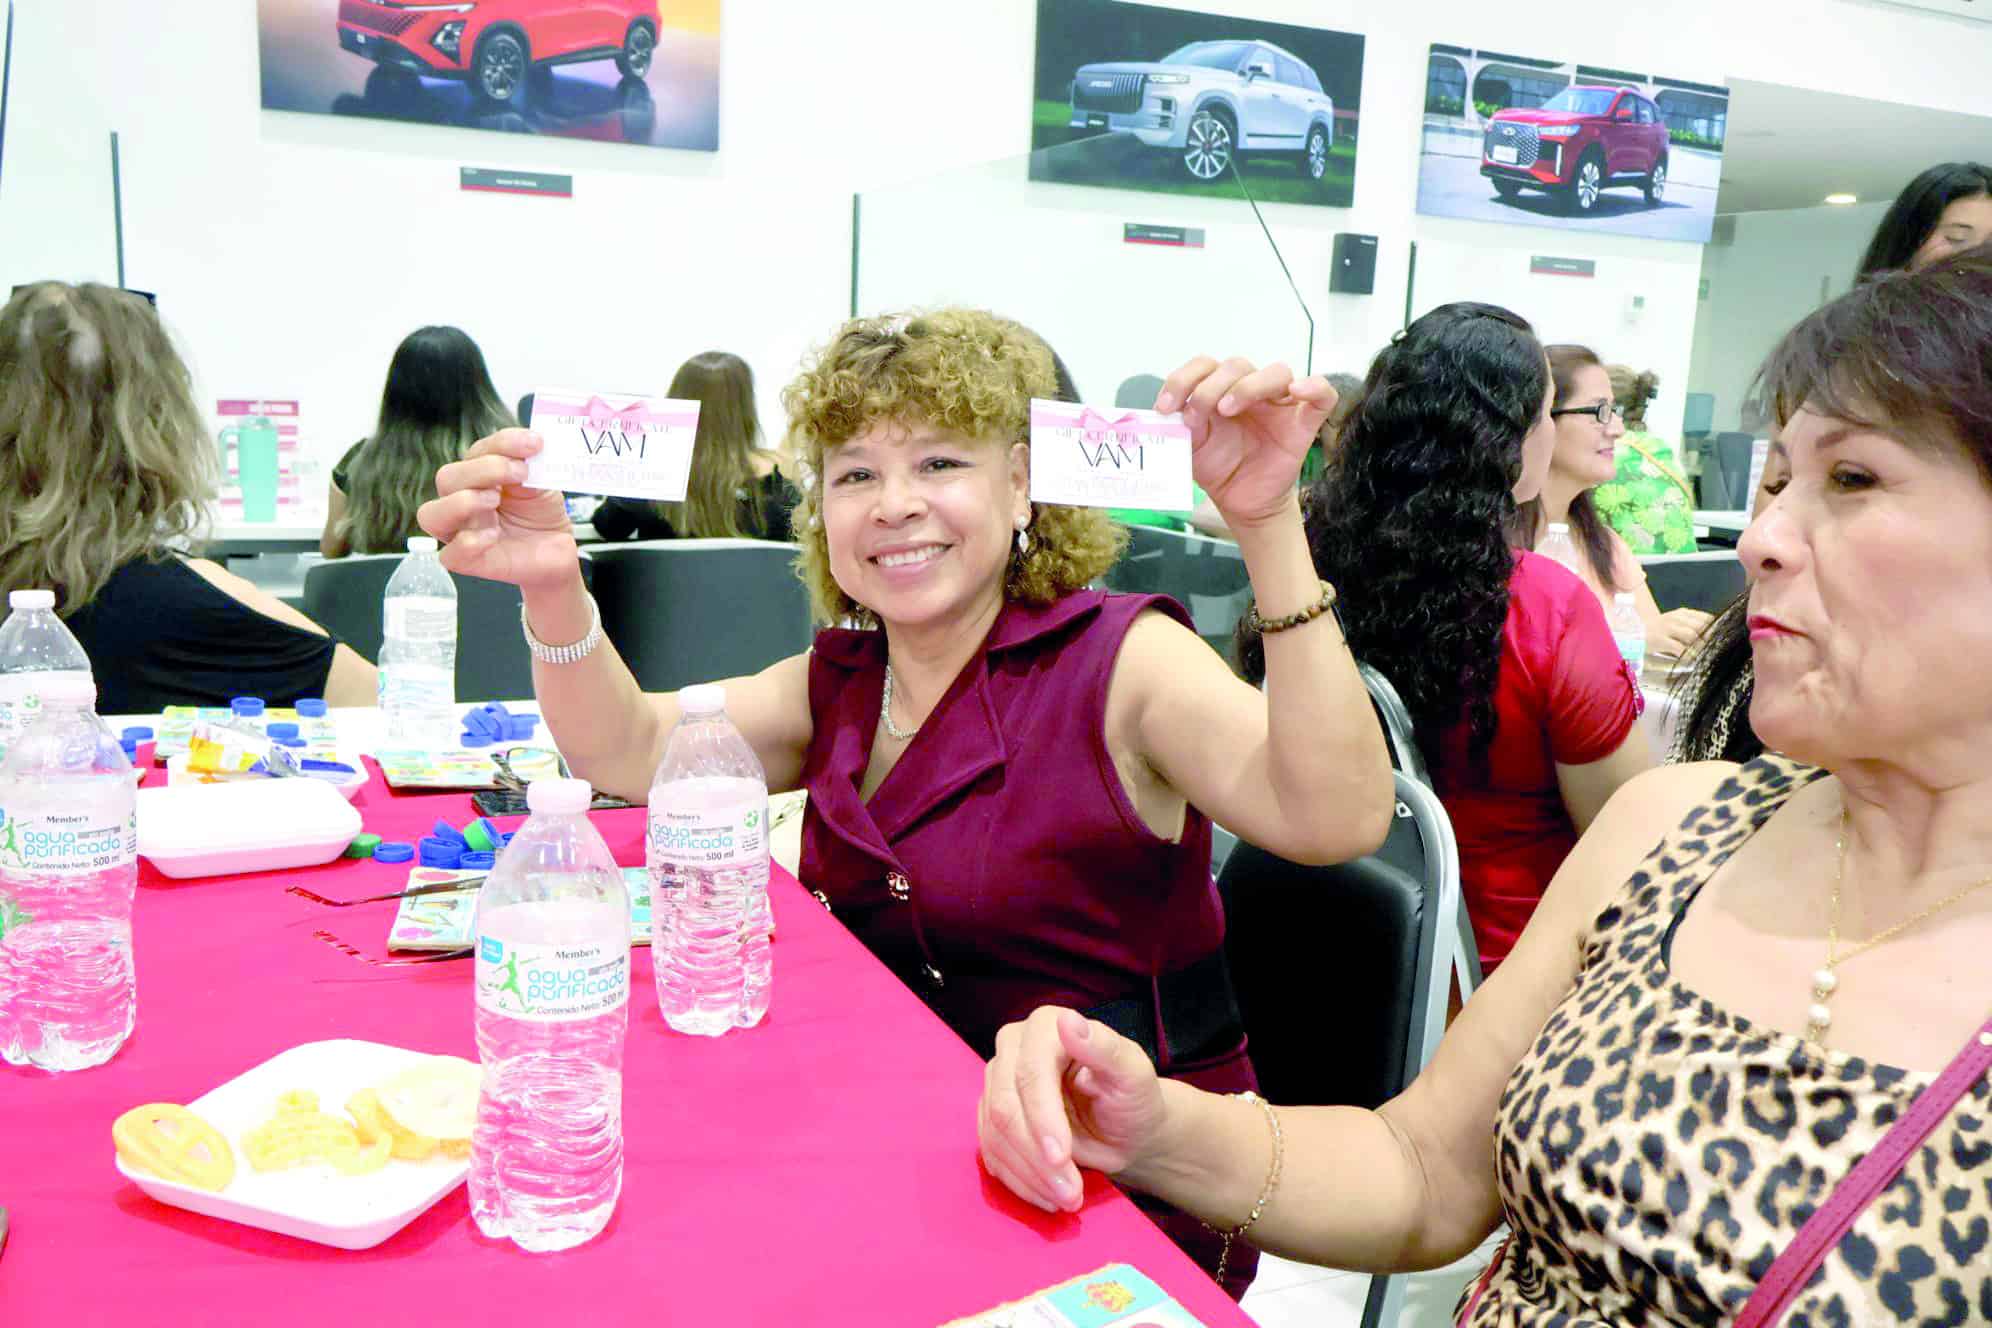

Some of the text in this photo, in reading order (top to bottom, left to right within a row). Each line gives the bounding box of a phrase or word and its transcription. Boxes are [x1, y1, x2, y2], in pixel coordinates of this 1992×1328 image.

[580, 428, 647, 459] VAM
[1078, 439, 1145, 471] VAM
[24, 831, 76, 848] agua
[655, 823, 689, 840] agua
[655, 831, 734, 849] purificada
[24, 834, 121, 858] purificada
[93, 855, 110, 867] 500
[706, 851, 722, 861] 500
[527, 968, 587, 990] agua
[527, 967, 624, 1001] purificada
[601, 992, 617, 1006] 500
